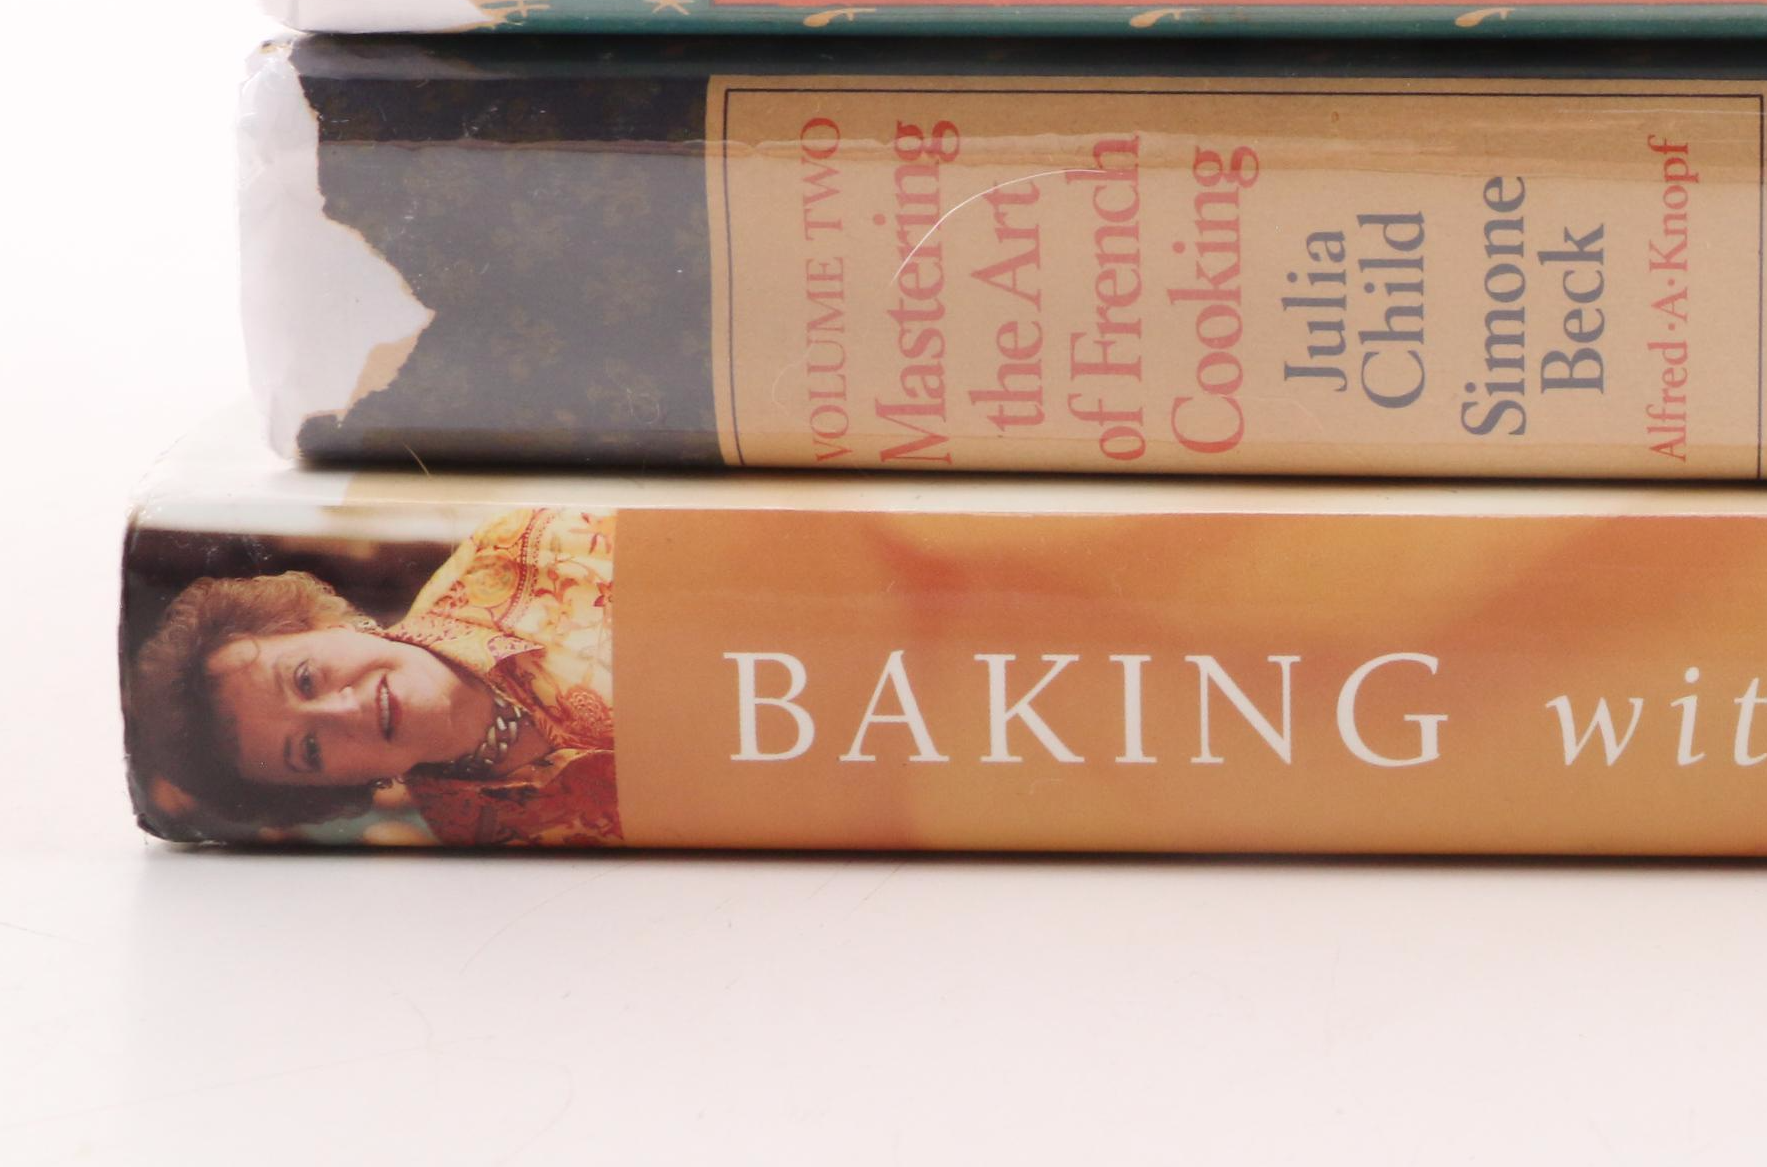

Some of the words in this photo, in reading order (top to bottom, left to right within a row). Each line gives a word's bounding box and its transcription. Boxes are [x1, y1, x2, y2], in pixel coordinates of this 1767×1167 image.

[799, 116, 844, 242] TWO
[969, 179, 1042, 313] Art
[1064, 134, 1144, 383] French
[805, 254, 854, 463] VOLUME
[872, 119, 961, 465] Mastering
[967, 319, 1046, 433] the
[1166, 144, 1260, 454] Cooking
[1280, 229, 1348, 393] Julia
[1356, 210, 1426, 409] Child
[1460, 175, 1527, 437] Simone
[1536, 222, 1605, 394] Beck
[1067, 392, 1147, 462] of
[722, 648, 1449, 768] BAKING
